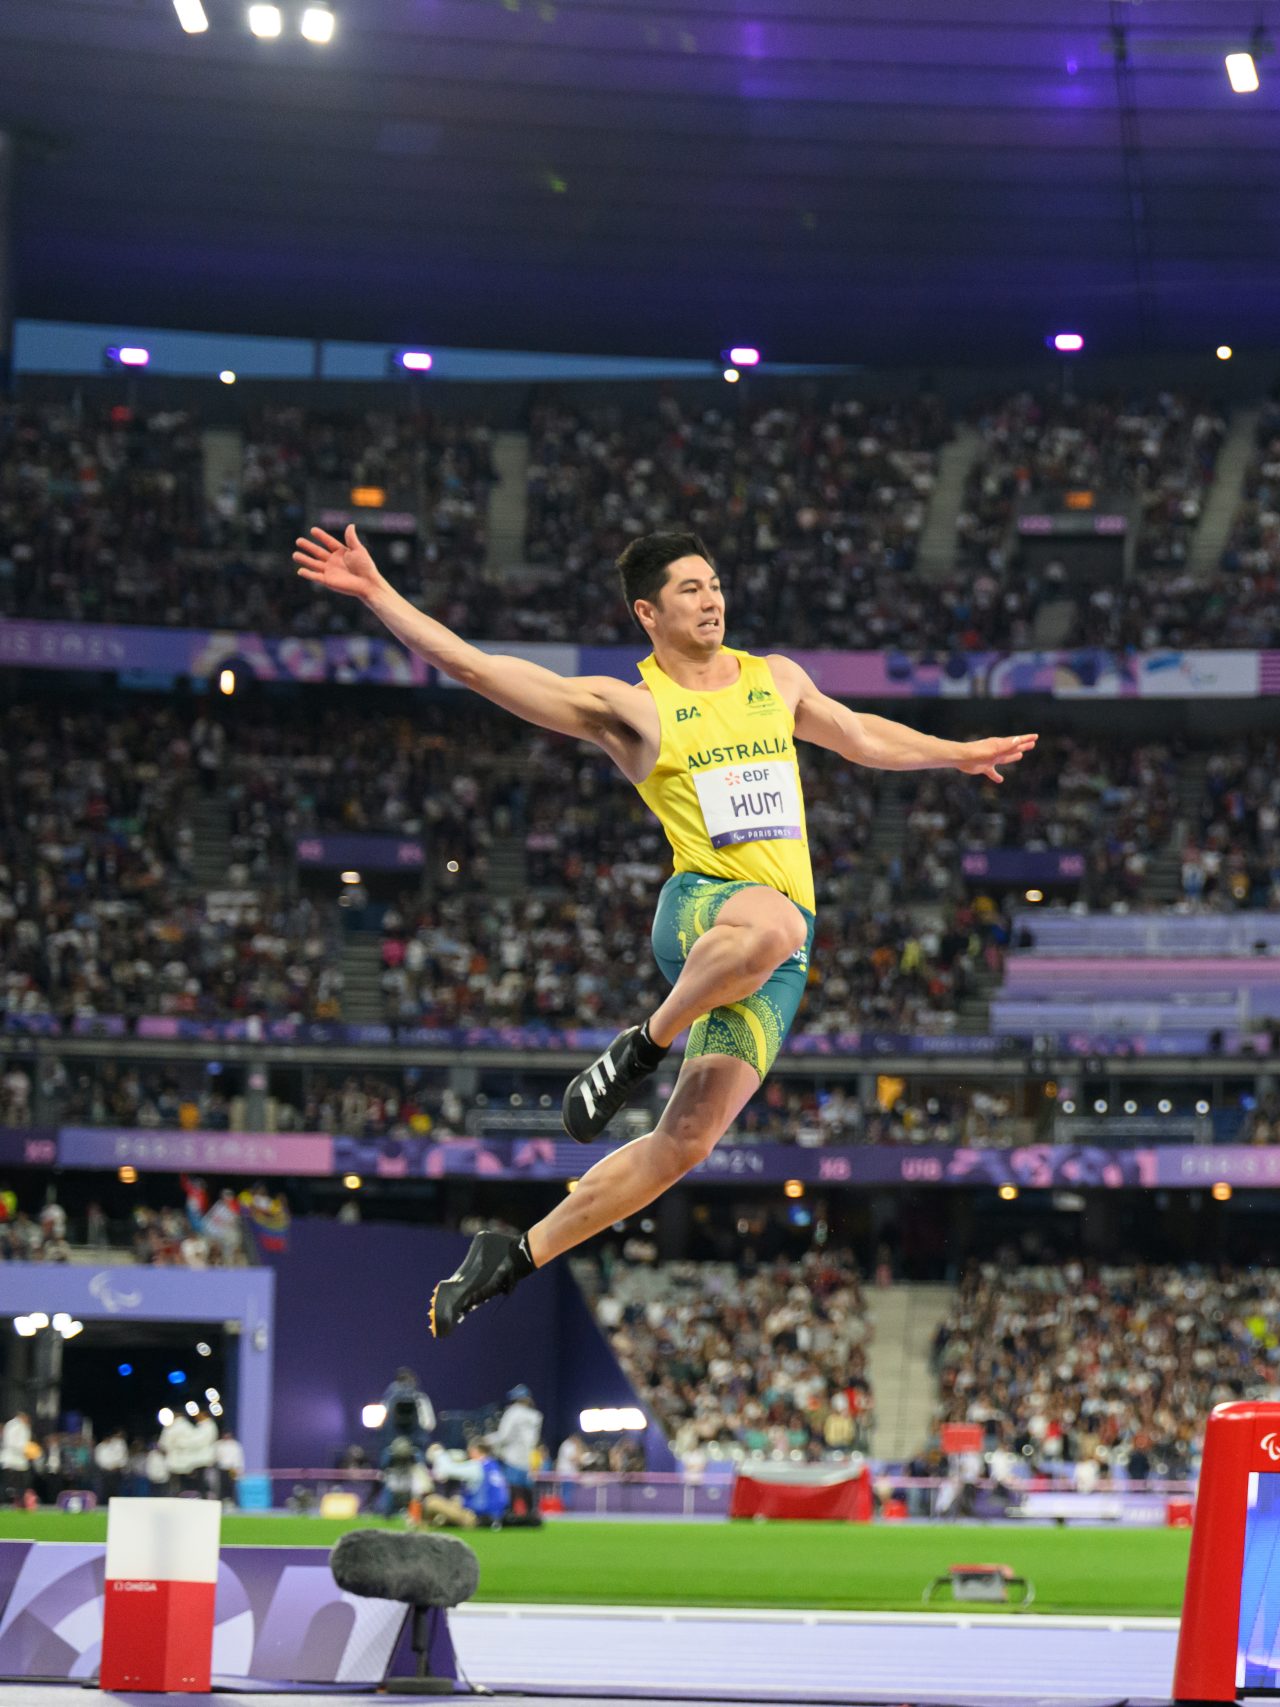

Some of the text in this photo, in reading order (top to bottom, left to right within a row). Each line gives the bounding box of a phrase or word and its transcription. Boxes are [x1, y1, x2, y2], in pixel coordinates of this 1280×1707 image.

[688, 737, 789, 770] AUSTRALIA
[730, 791, 785, 818] HUM
[747, 829, 772, 839] PARIS
[792, 950, 808, 964] US
